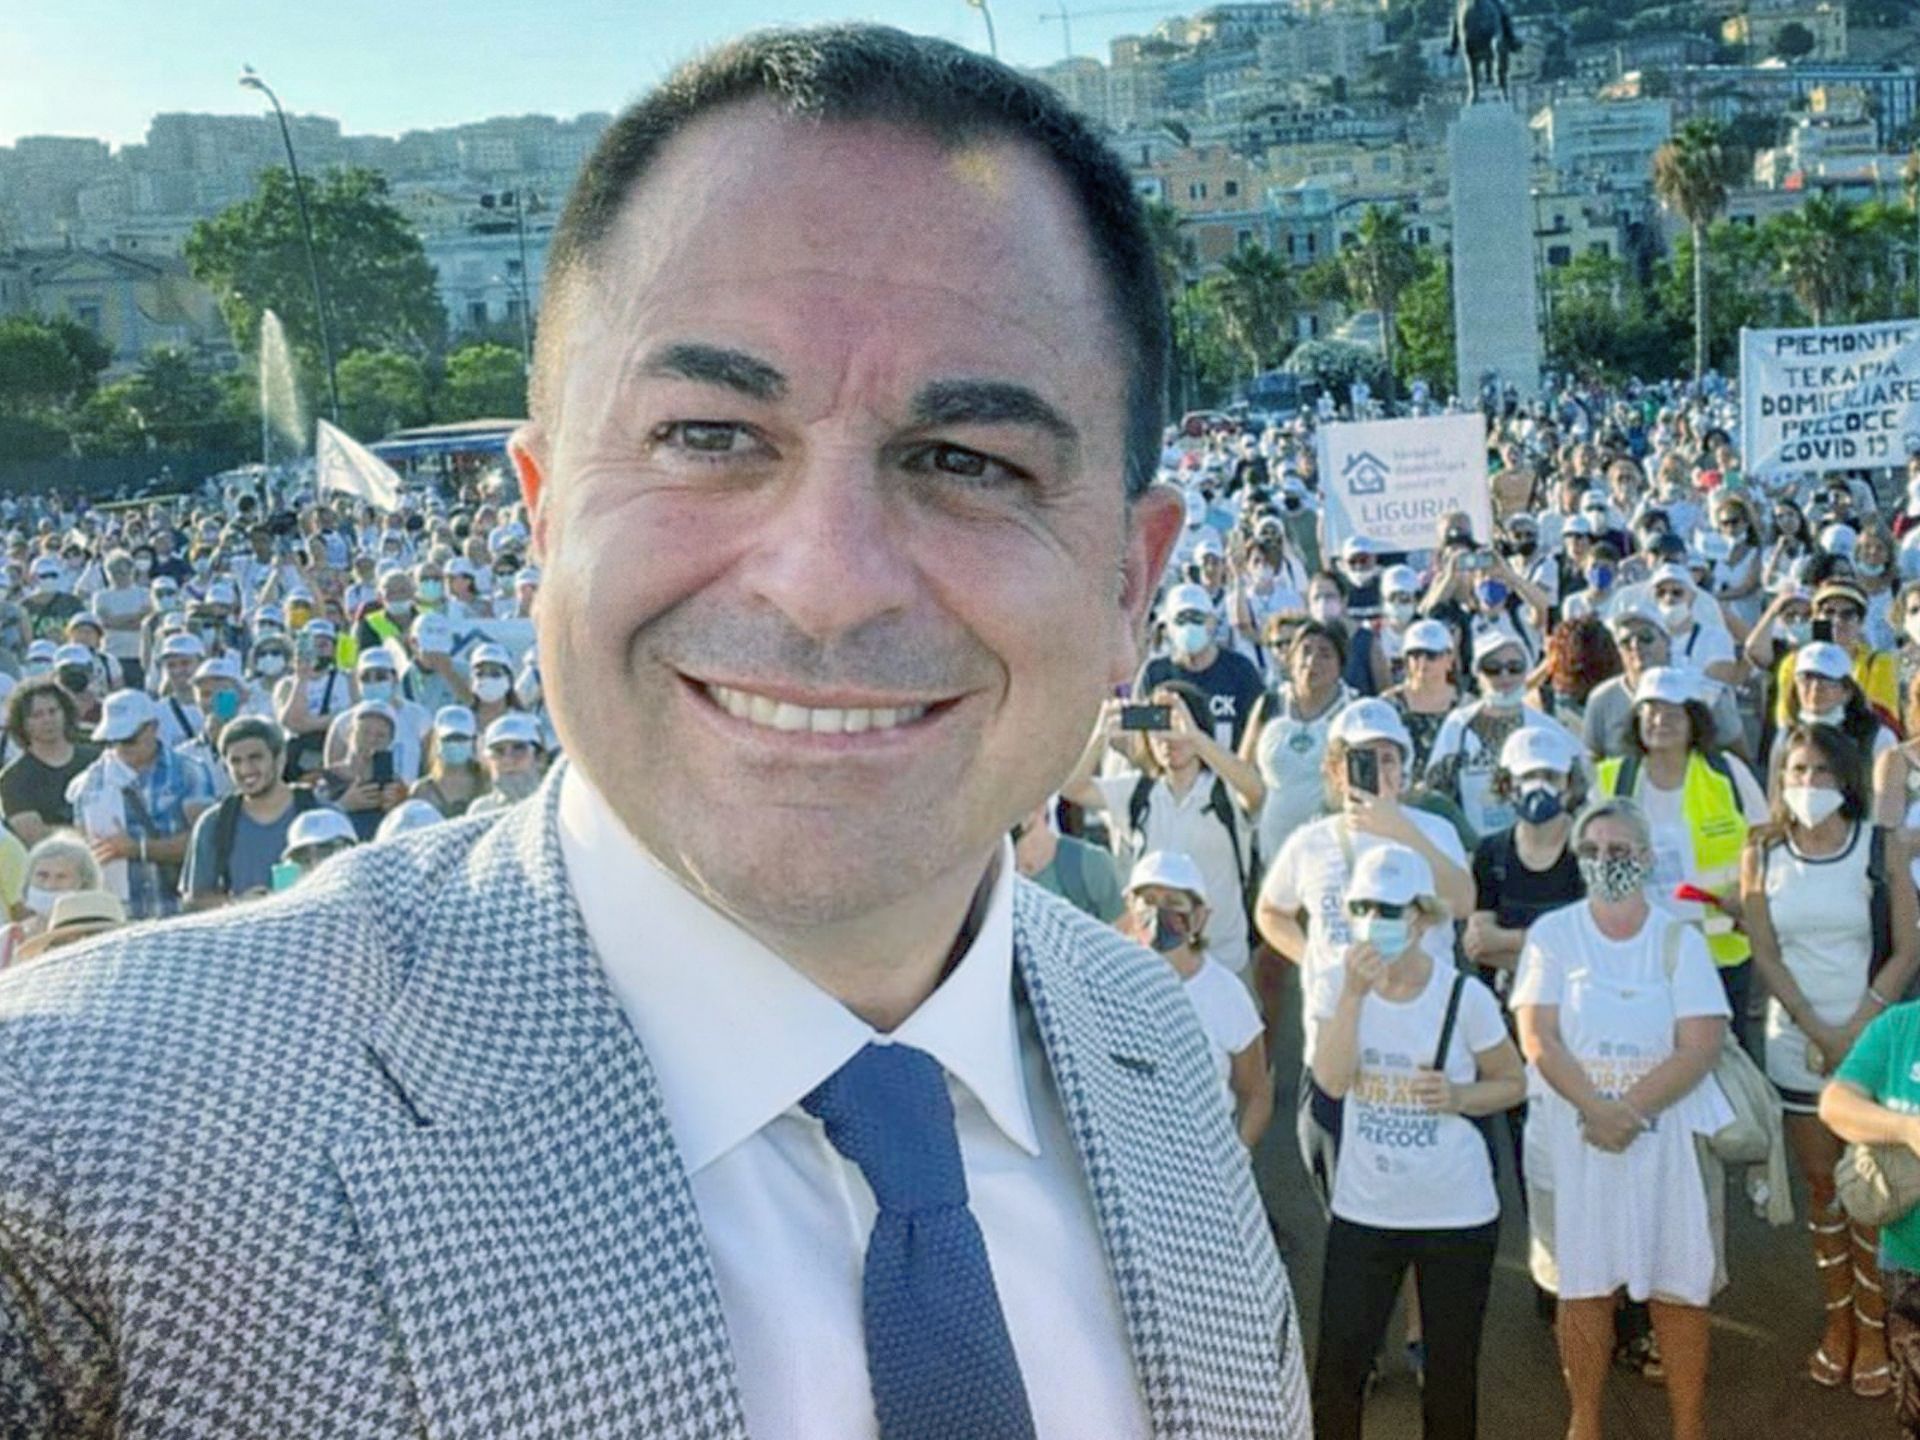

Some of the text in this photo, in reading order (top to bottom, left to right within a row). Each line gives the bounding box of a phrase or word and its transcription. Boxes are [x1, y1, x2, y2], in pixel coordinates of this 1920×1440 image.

[1776, 327, 1914, 356] PIEMONTE
[1784, 360, 1900, 388] TERAPIA
[1781, 409, 1898, 439] PRECOCE
[1780, 438, 1856, 463] COVID
